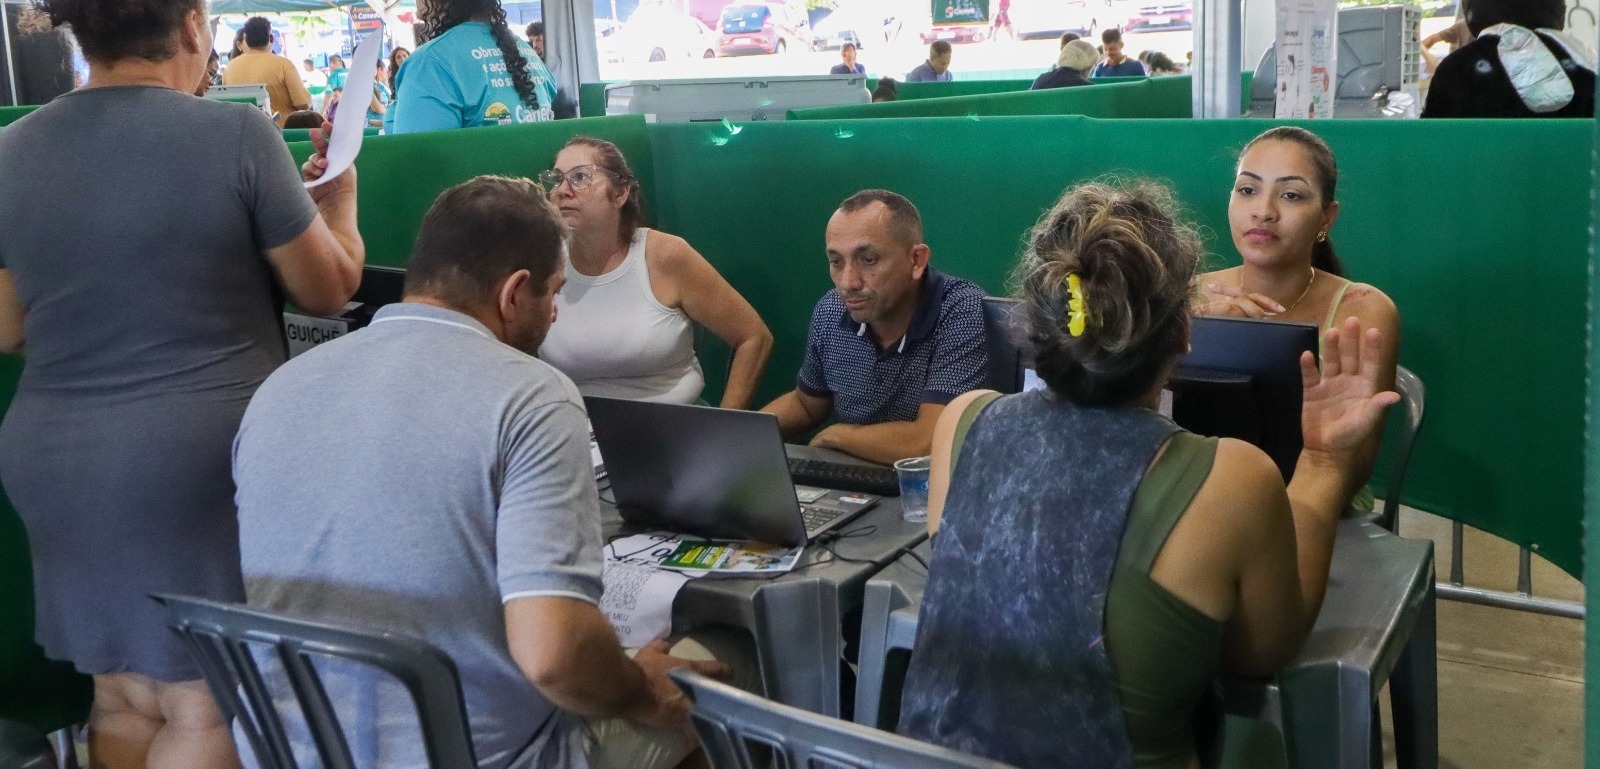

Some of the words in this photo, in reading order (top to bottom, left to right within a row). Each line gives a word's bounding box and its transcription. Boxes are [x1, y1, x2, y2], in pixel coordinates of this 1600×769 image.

[490, 77, 504, 88] no
[287, 323, 340, 344] GUICHÊ
[612, 612, 628, 621] MEU
